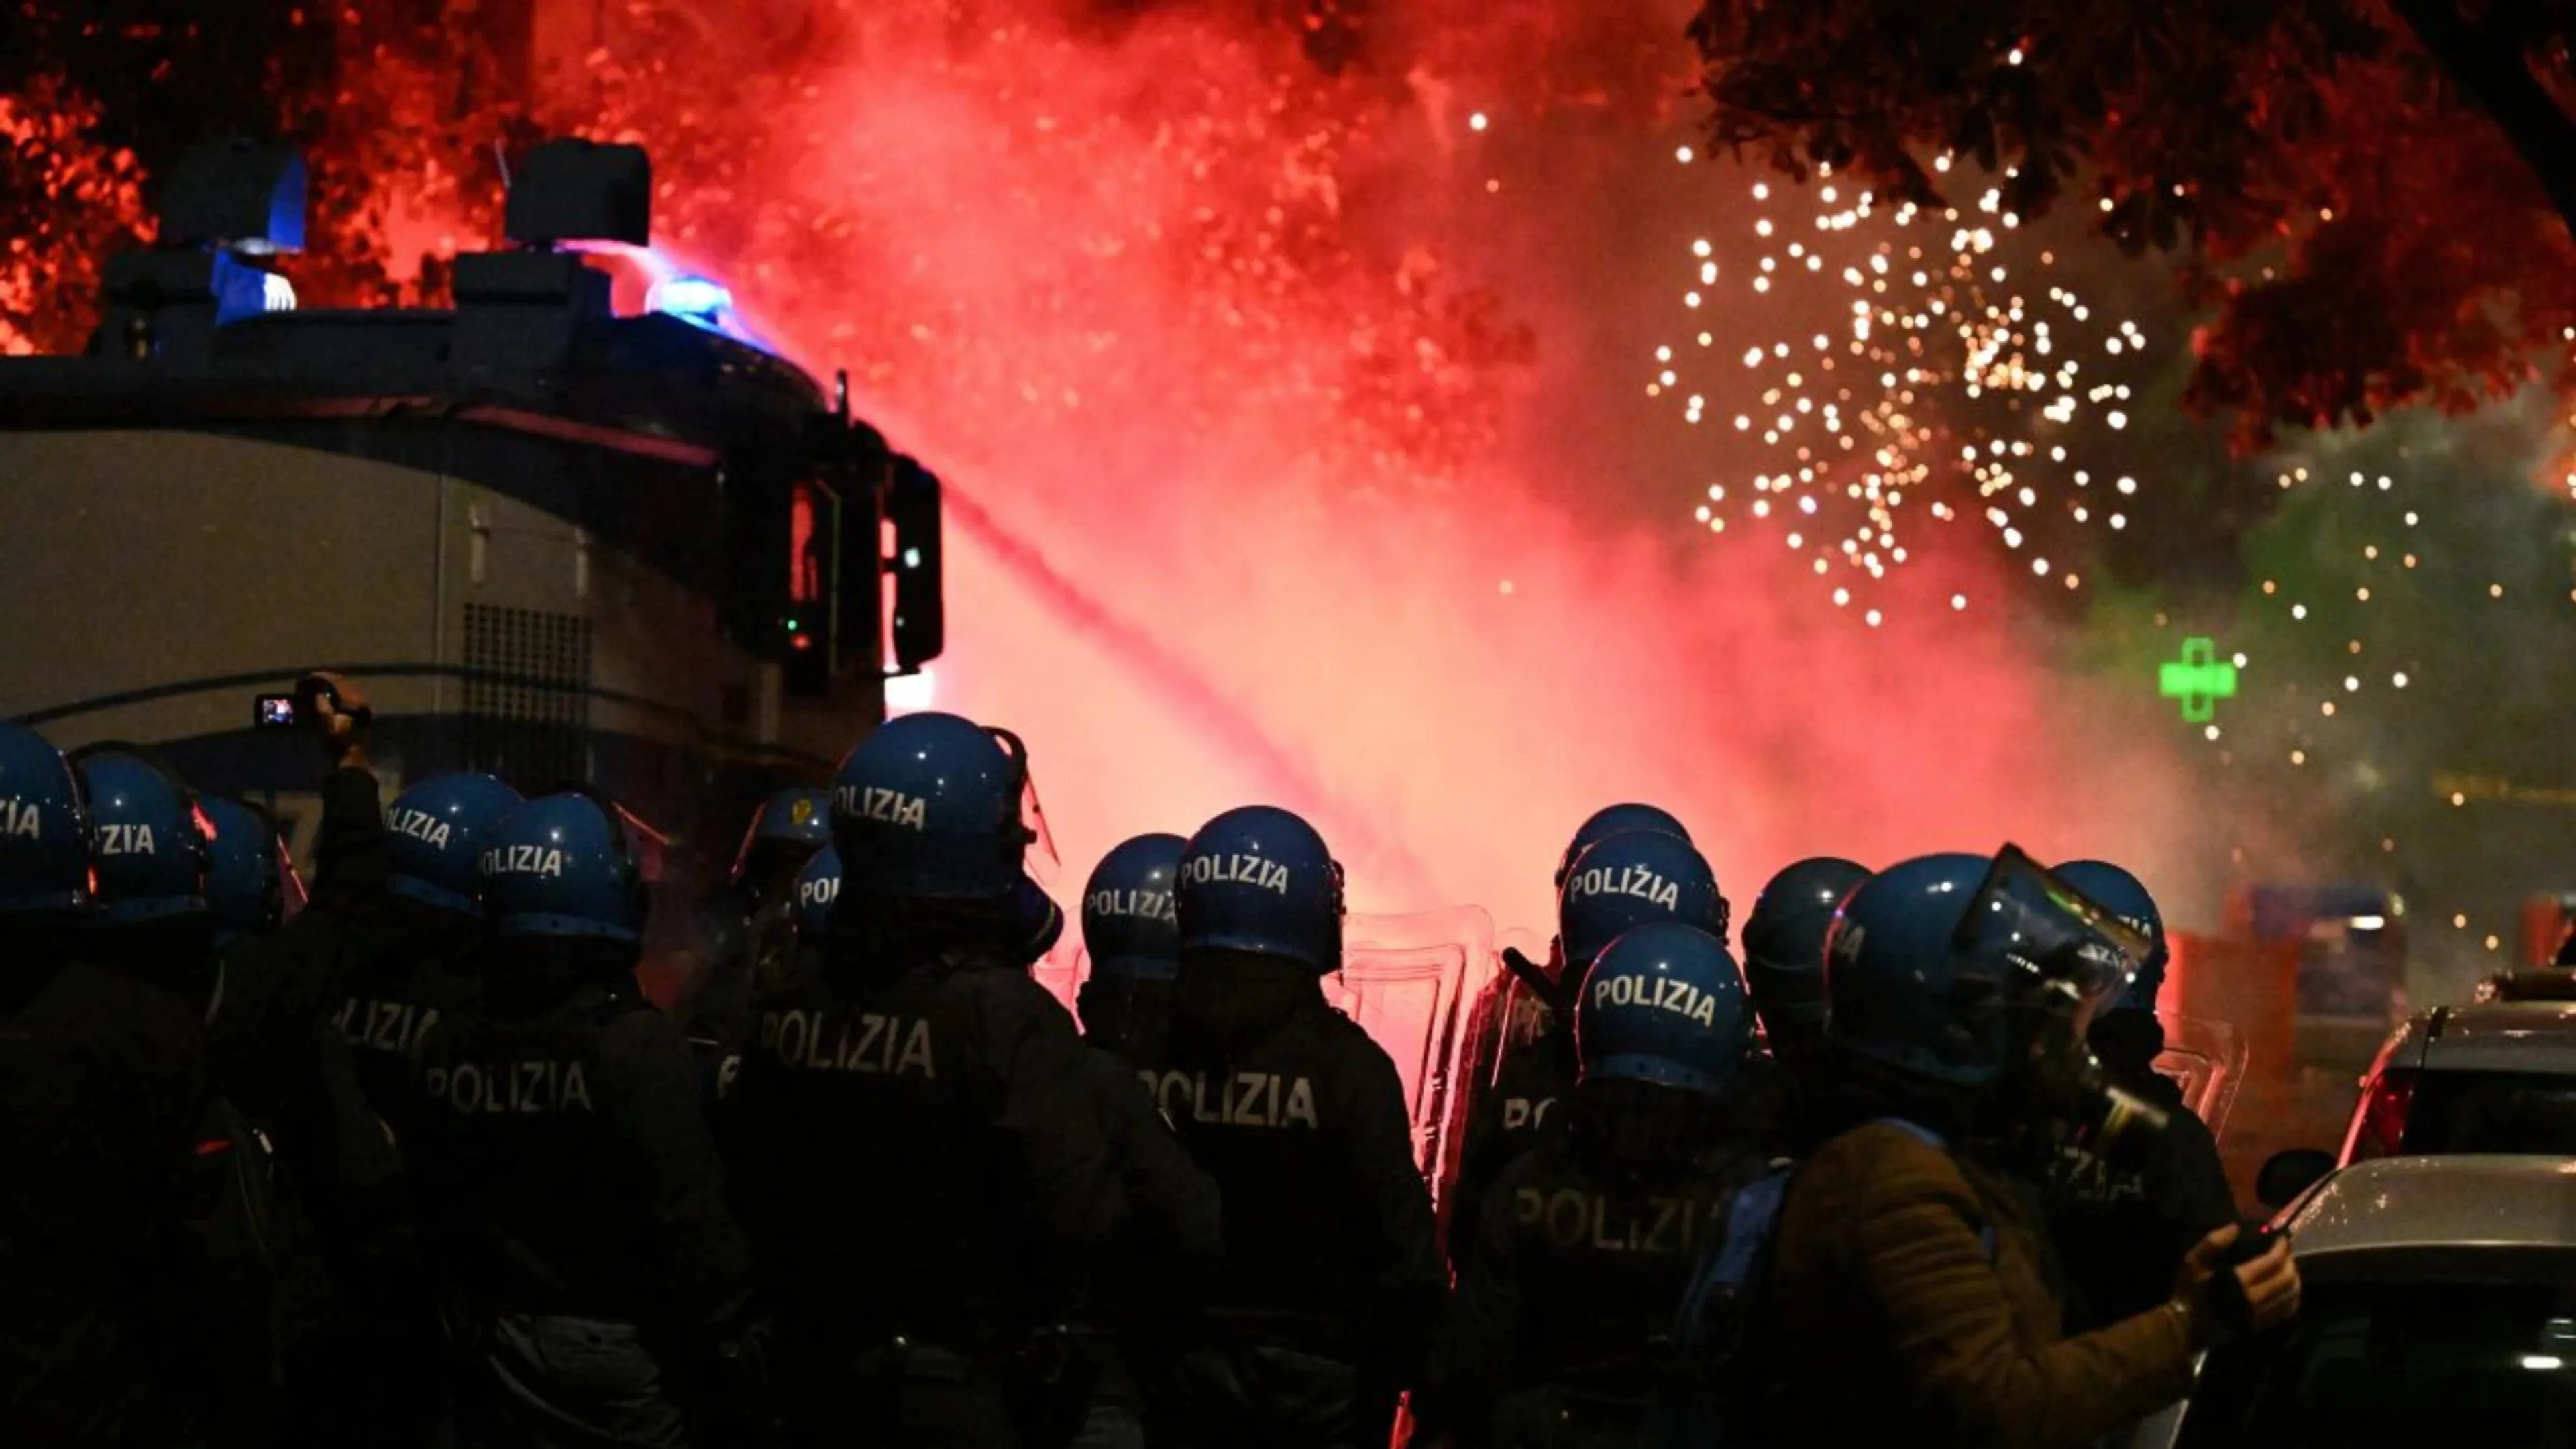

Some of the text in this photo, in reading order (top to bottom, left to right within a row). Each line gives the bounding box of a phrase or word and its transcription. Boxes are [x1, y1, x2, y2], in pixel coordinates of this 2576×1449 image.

[1181, 853, 1289, 896] POLIZIA
[1570, 865, 1679, 912] POLIZIA
[1594, 974, 1716, 1027] POLIZIA
[761, 1008, 937, 1081] POLIZIA
[427, 1060, 596, 1116] POLIZIA
[1515, 1188, 1722, 1254] POLIZI
